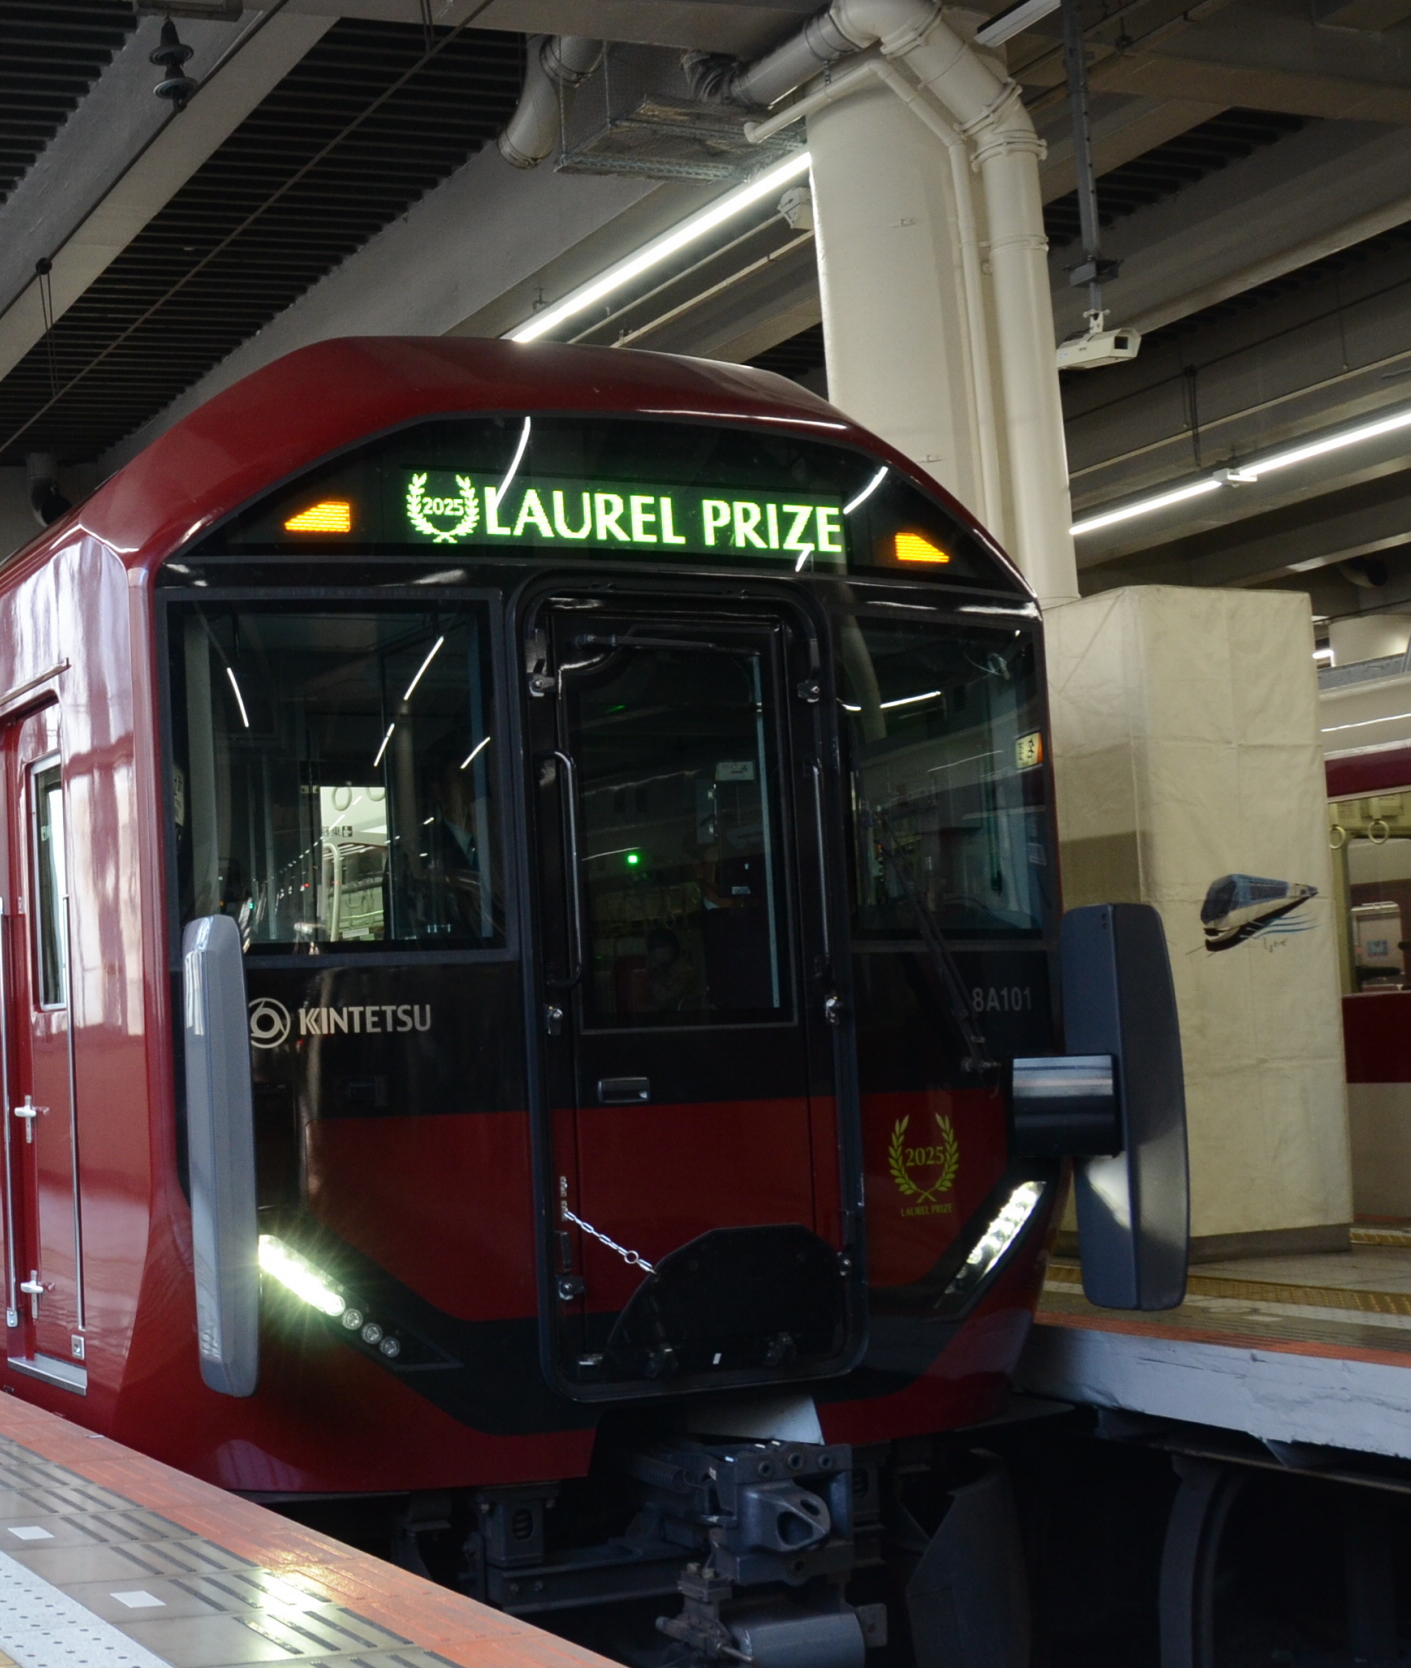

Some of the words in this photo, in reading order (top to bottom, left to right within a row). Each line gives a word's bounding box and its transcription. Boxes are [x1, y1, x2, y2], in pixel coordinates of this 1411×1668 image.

[422, 497, 464, 516] 2025
[484, 486, 685, 545] LAUREL
[703, 498, 842, 553] PRIZE
[972, 986, 1032, 1012] 8A101
[299, 1004, 431, 1035] KINTETSU
[905, 1146, 945, 1167] 2025
[901, 1205, 929, 1217] LAUREL
[932, 1203, 954, 1214] PRIZE
